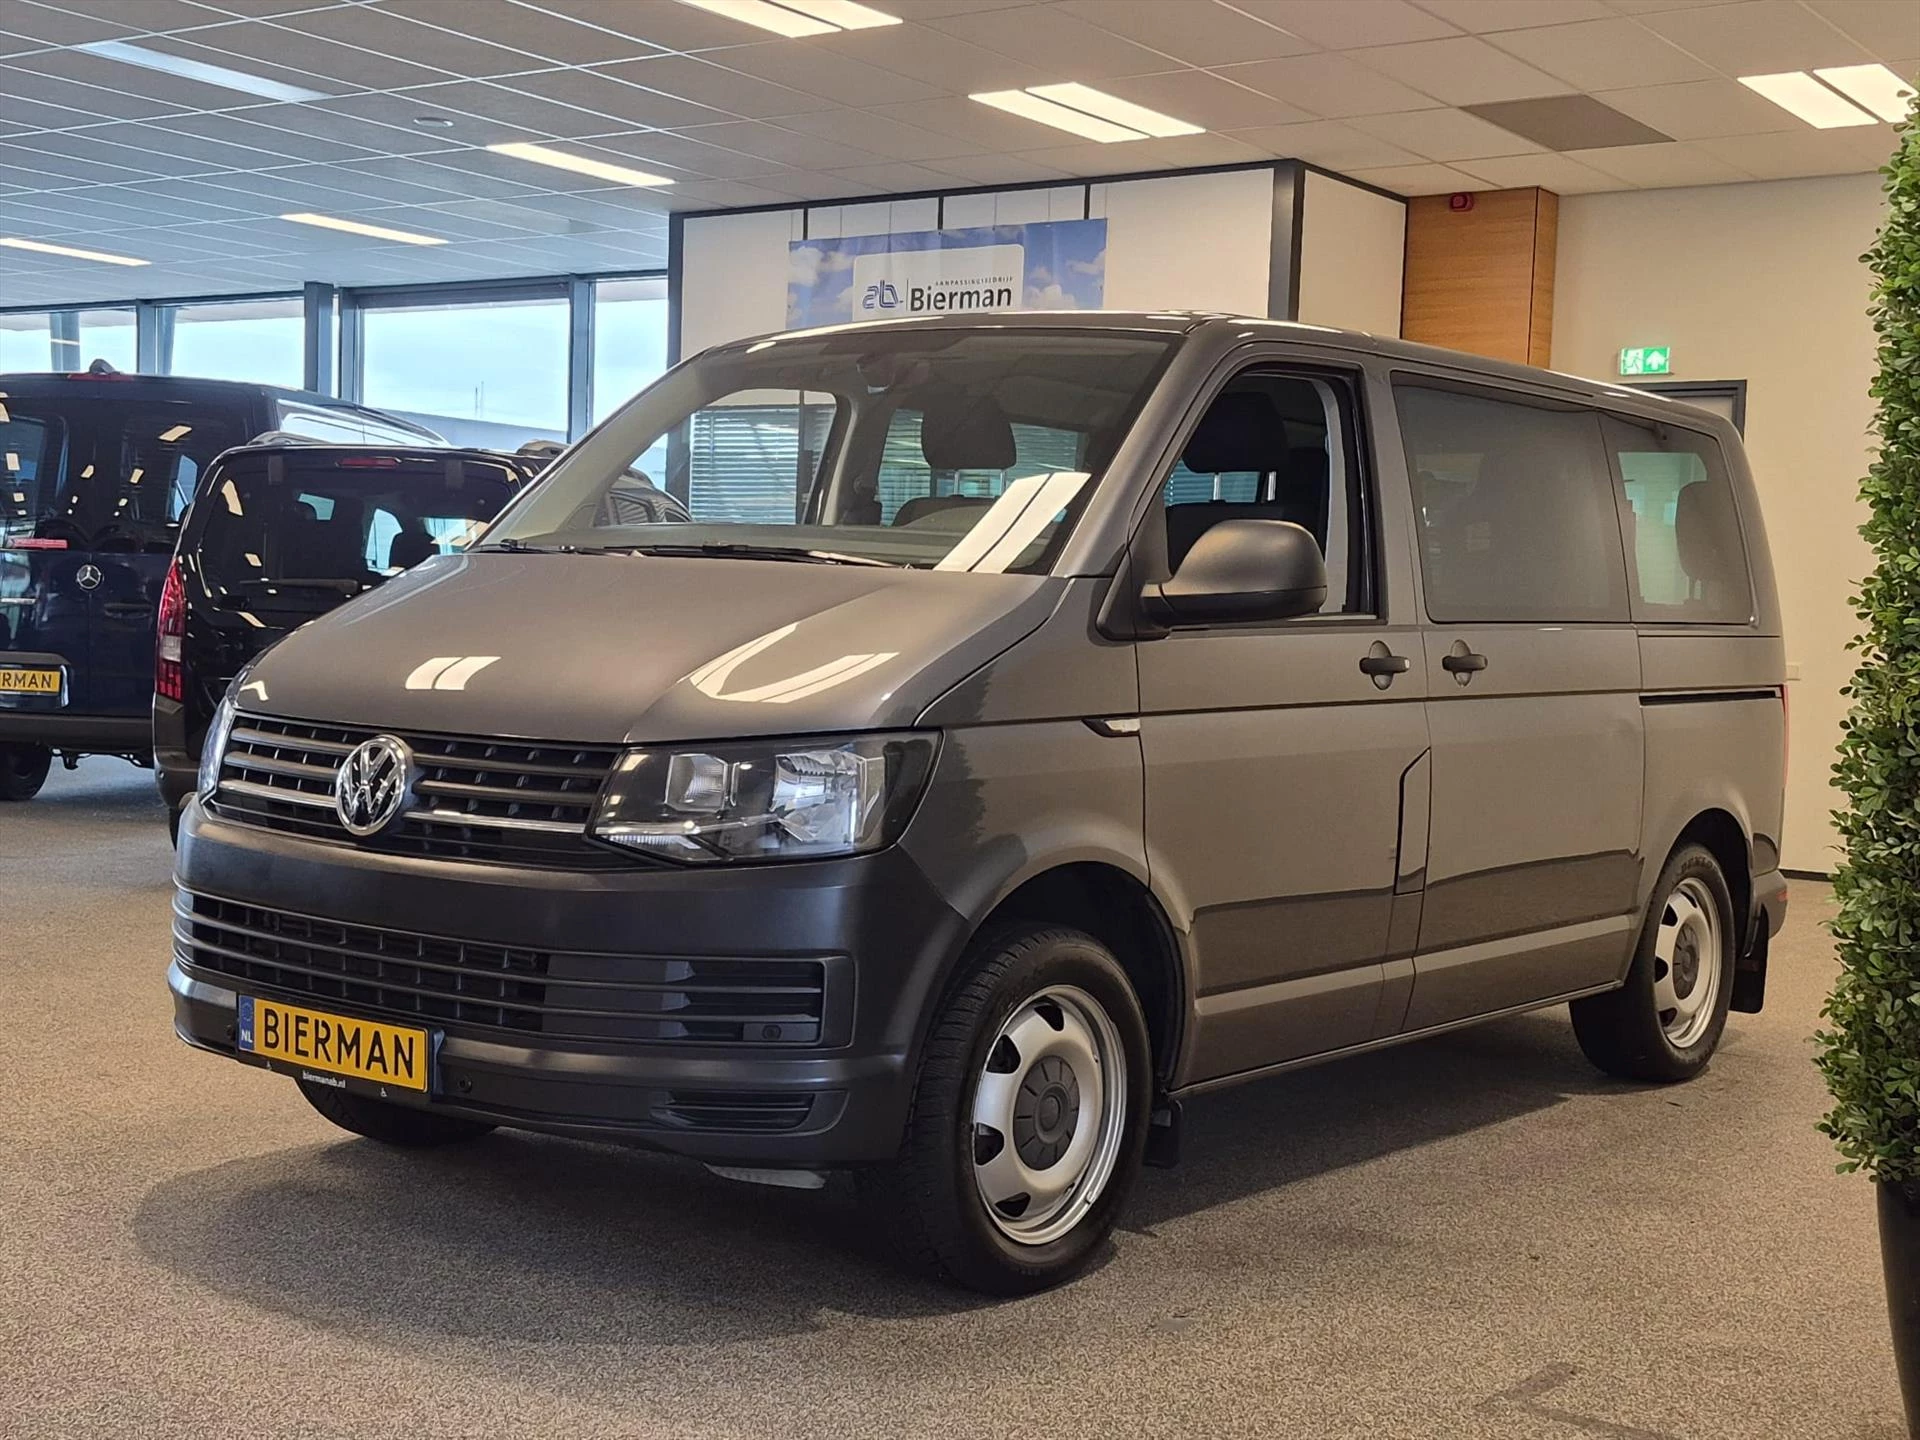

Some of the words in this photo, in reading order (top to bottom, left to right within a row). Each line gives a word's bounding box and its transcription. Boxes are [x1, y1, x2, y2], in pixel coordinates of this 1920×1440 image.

[910, 285, 1013, 312] Bierman
[241, 1028, 253, 1044] NL
[263, 1007, 414, 1079] BIERMAN
